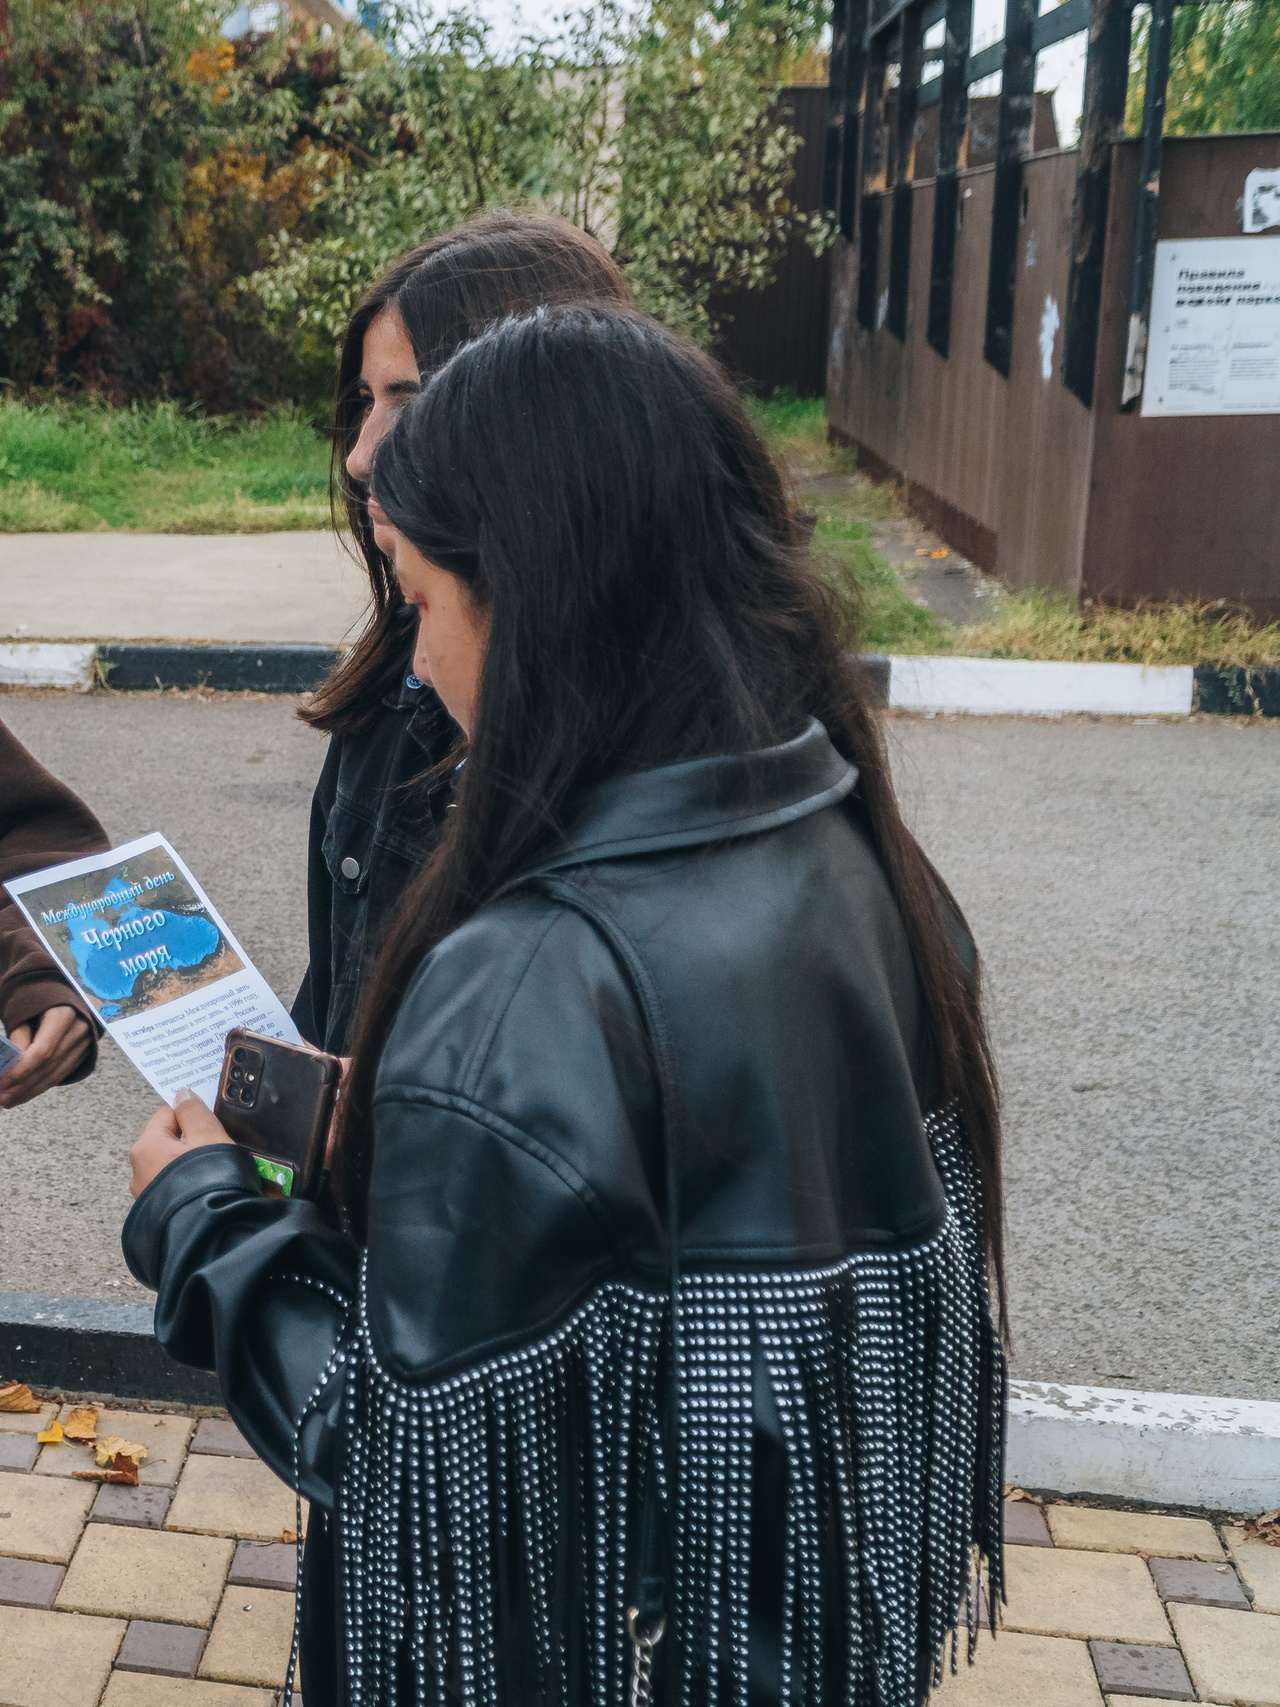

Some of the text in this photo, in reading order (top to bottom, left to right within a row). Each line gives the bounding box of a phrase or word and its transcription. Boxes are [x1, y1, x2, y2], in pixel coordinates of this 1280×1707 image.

[41, 871, 175, 926] Международный день
[80, 910, 166, 951] Черного
[120, 945, 172, 976] моря
[131, 1025, 155, 1036] октября
[154, 1013, 185, 1029] отмечается
[184, 990, 235, 1016] Международный
[236, 984, 250, 994] день
[166, 1024, 189, 1036] Именно
[194, 1015, 208, 1025] этот
[228, 999, 244, 1009] 1996
[209, 1019, 227, 1031] стран
[234, 1005, 258, 1019] Россия,
[181, 1044, 224, 1067] Стратегический
